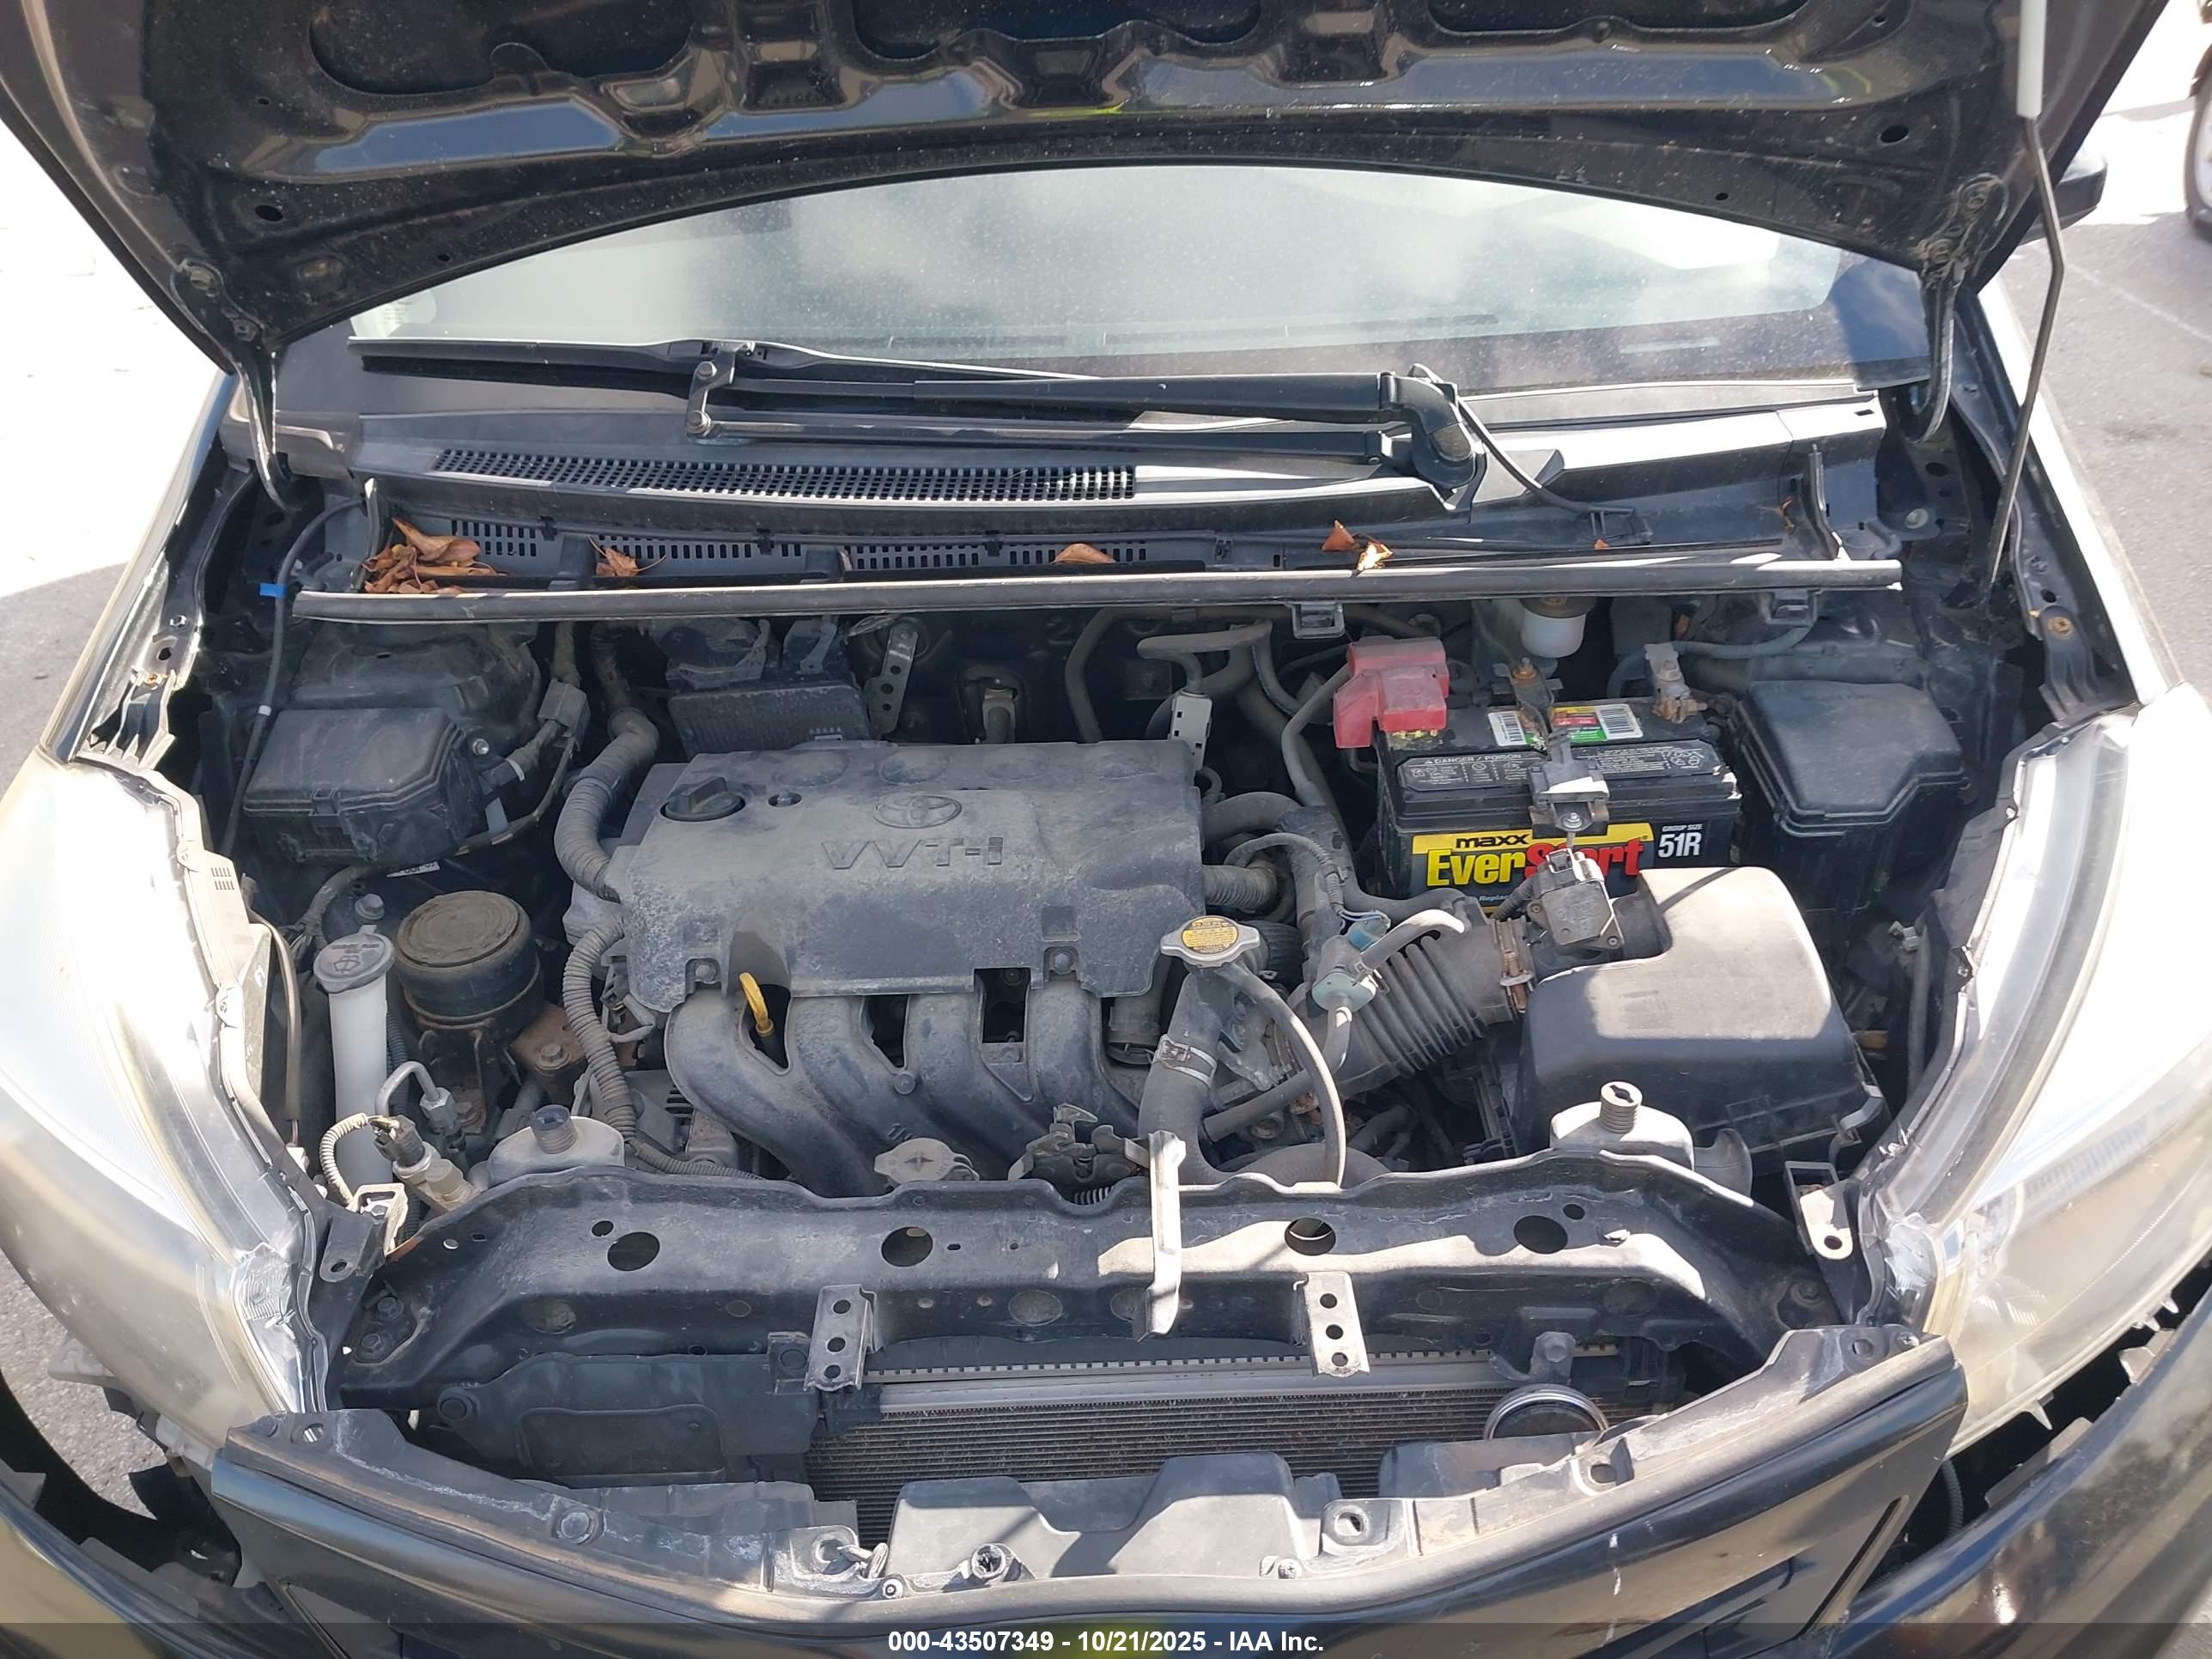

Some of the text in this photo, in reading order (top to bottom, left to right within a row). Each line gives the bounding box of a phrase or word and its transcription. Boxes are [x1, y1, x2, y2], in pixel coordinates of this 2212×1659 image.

[1456, 834, 1530, 848] maxx
[1658, 832, 1702, 858] 51R
[1427, 836, 1644, 886] EverSrt
